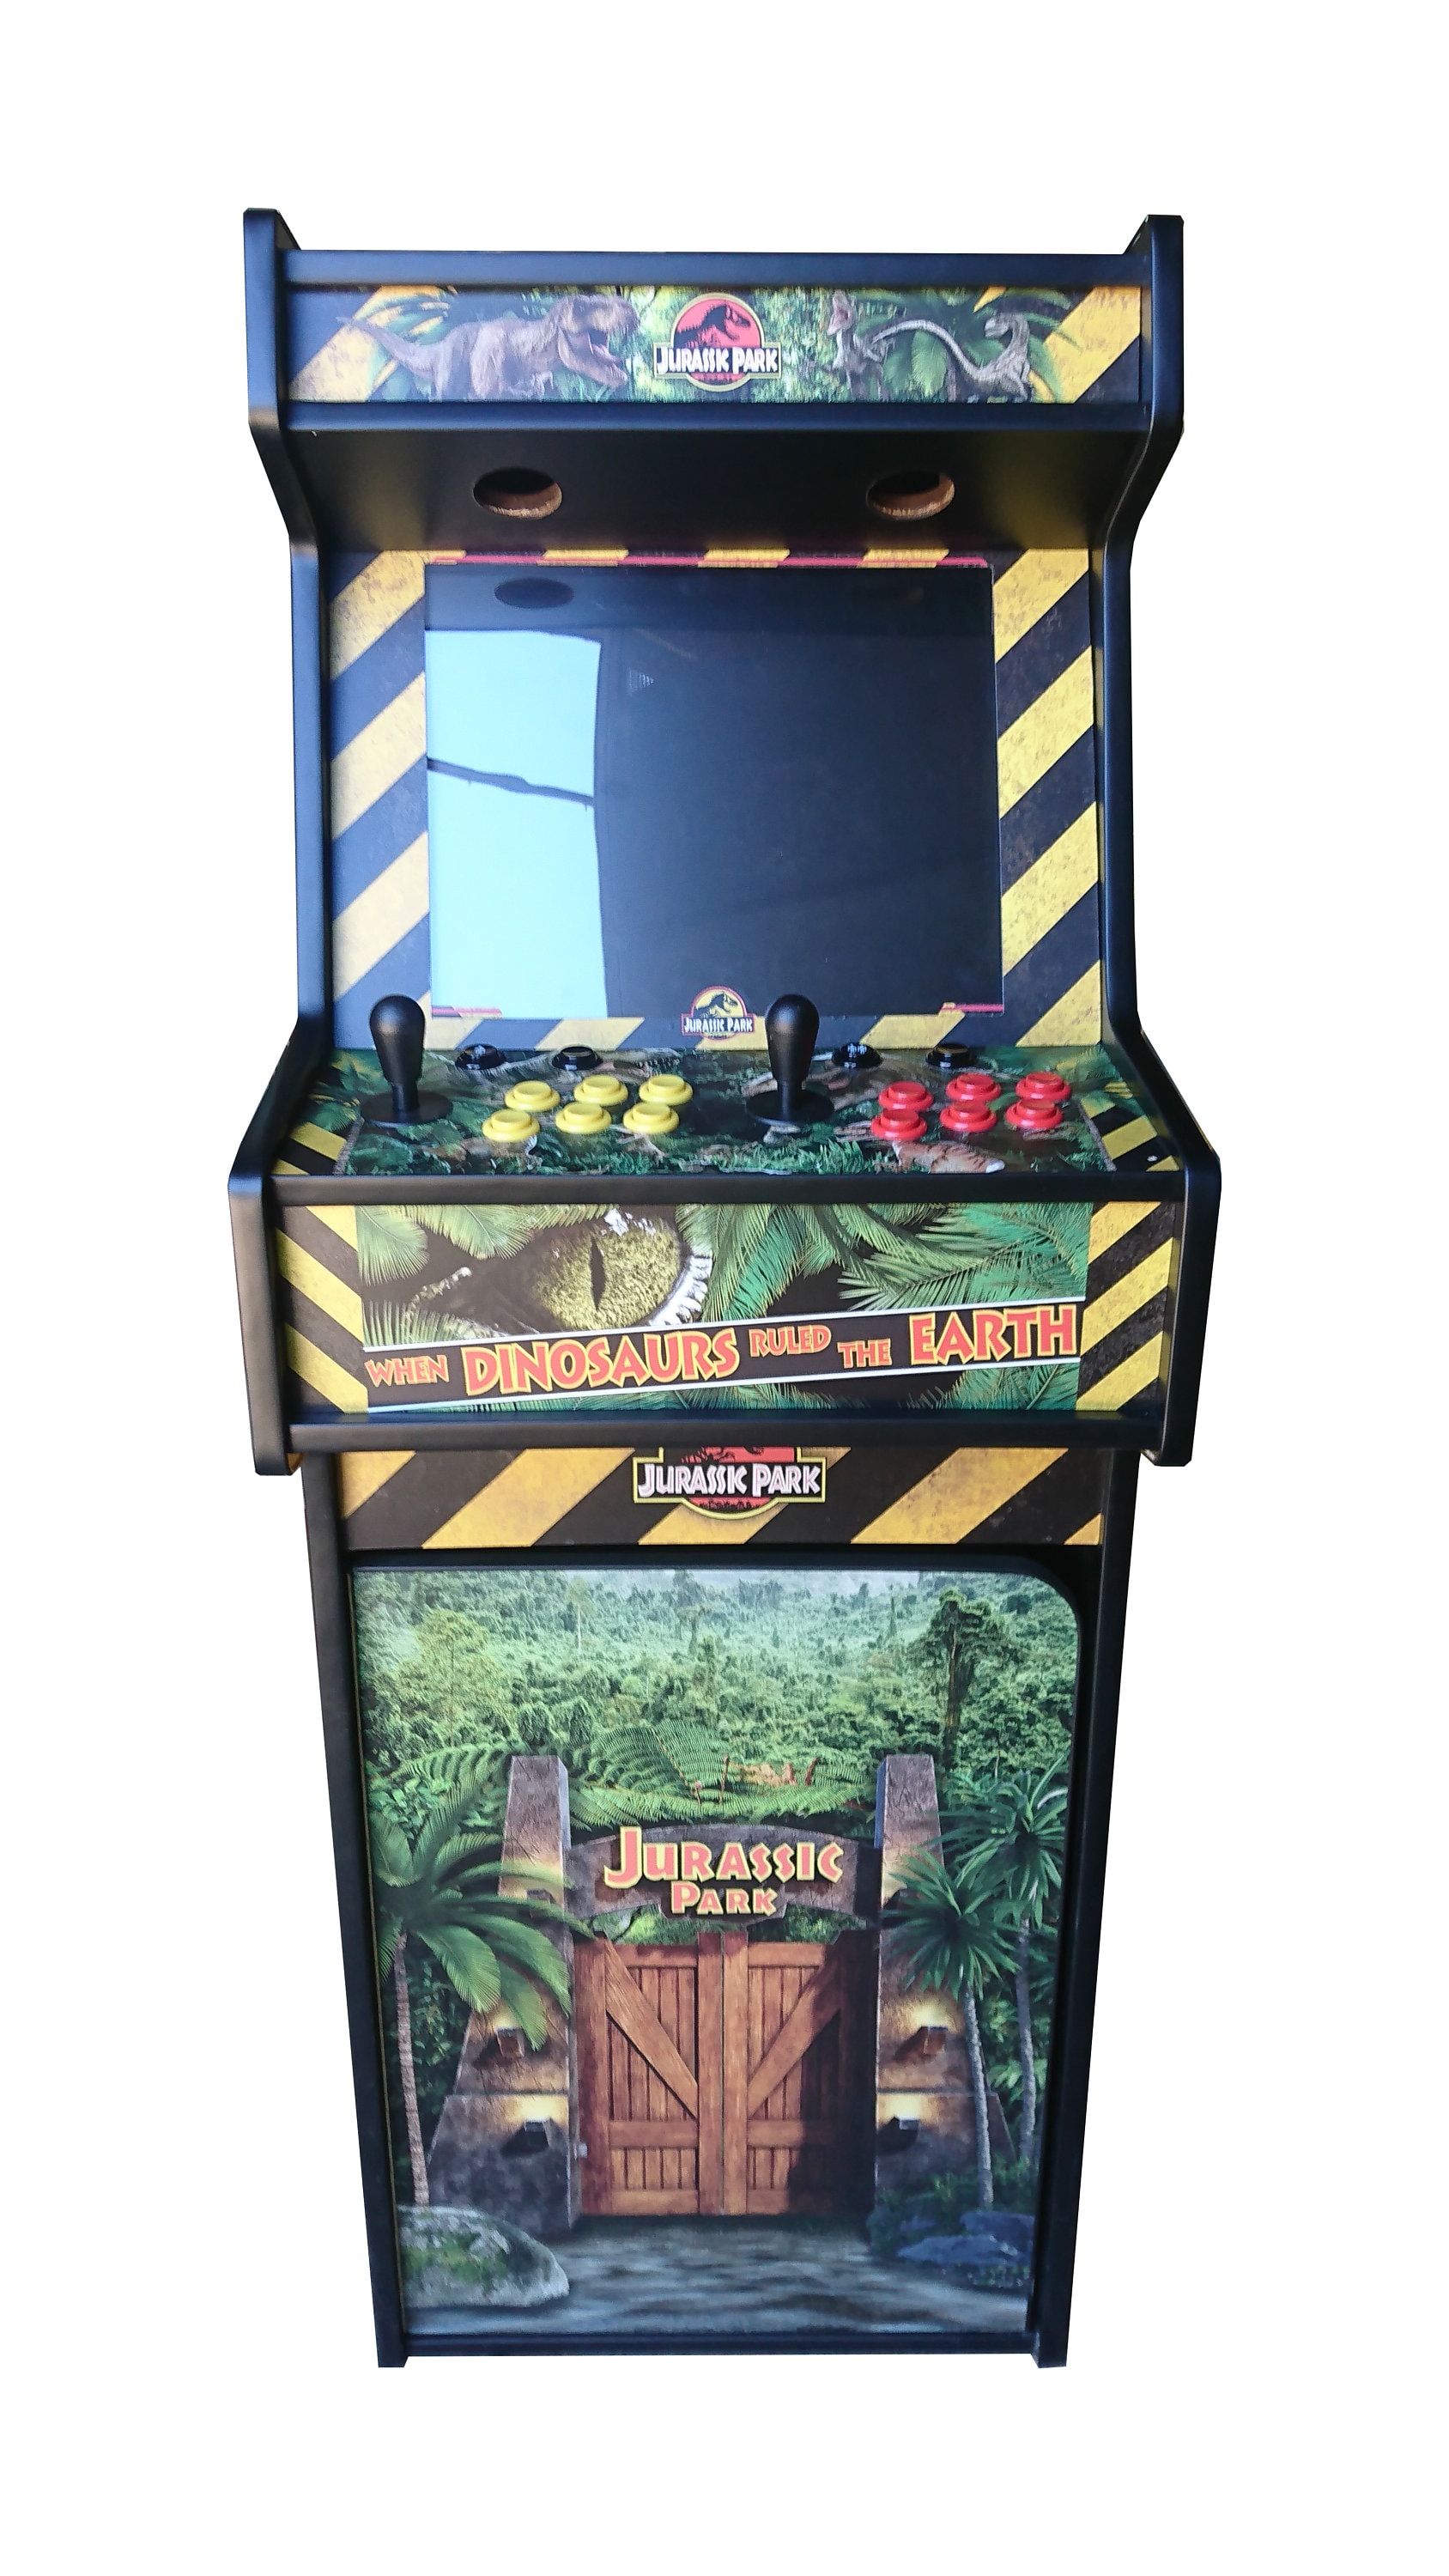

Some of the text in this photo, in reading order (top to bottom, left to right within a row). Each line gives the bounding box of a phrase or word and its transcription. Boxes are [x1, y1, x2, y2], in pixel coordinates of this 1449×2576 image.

[657, 346, 778, 374] JURASSIC PARK
[684, 1017, 753, 1033] JURASSIC PARK
[364, 1303, 1077, 1396] WHEN DINOSAURS RULED THE EARTH
[638, 1462, 822, 1498] JURASSIC PARK
[603, 1826, 845, 1889] JURASSIC
[670, 1880, 779, 1917] PARK
